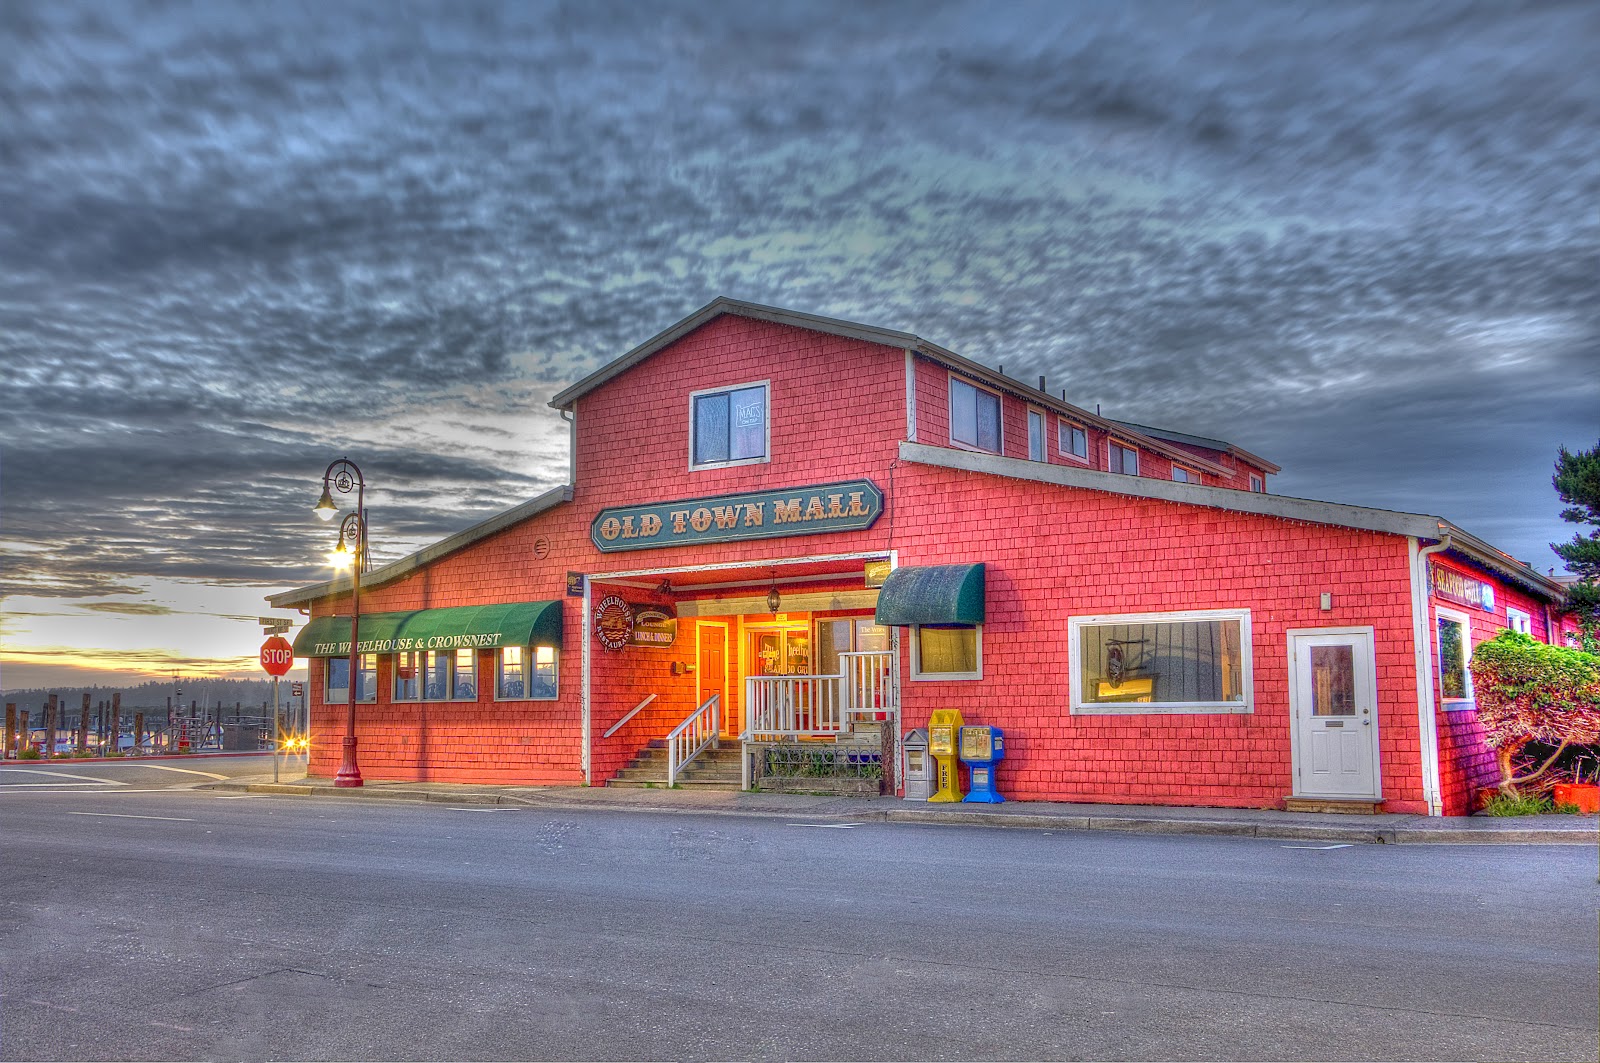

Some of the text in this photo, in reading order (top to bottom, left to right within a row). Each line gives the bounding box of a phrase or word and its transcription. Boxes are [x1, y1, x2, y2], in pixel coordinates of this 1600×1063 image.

[600, 491, 870, 541] OLD TOWN MALL
[596, 596, 632, 622] WHEELHOUSE
[314, 643, 336, 655] THE
[415, 638, 424, 649] &
[427, 633, 502, 649] CROWSNEST
[597, 625, 631, 649] RESTAURANT
[262, 648, 292, 664] STOP
